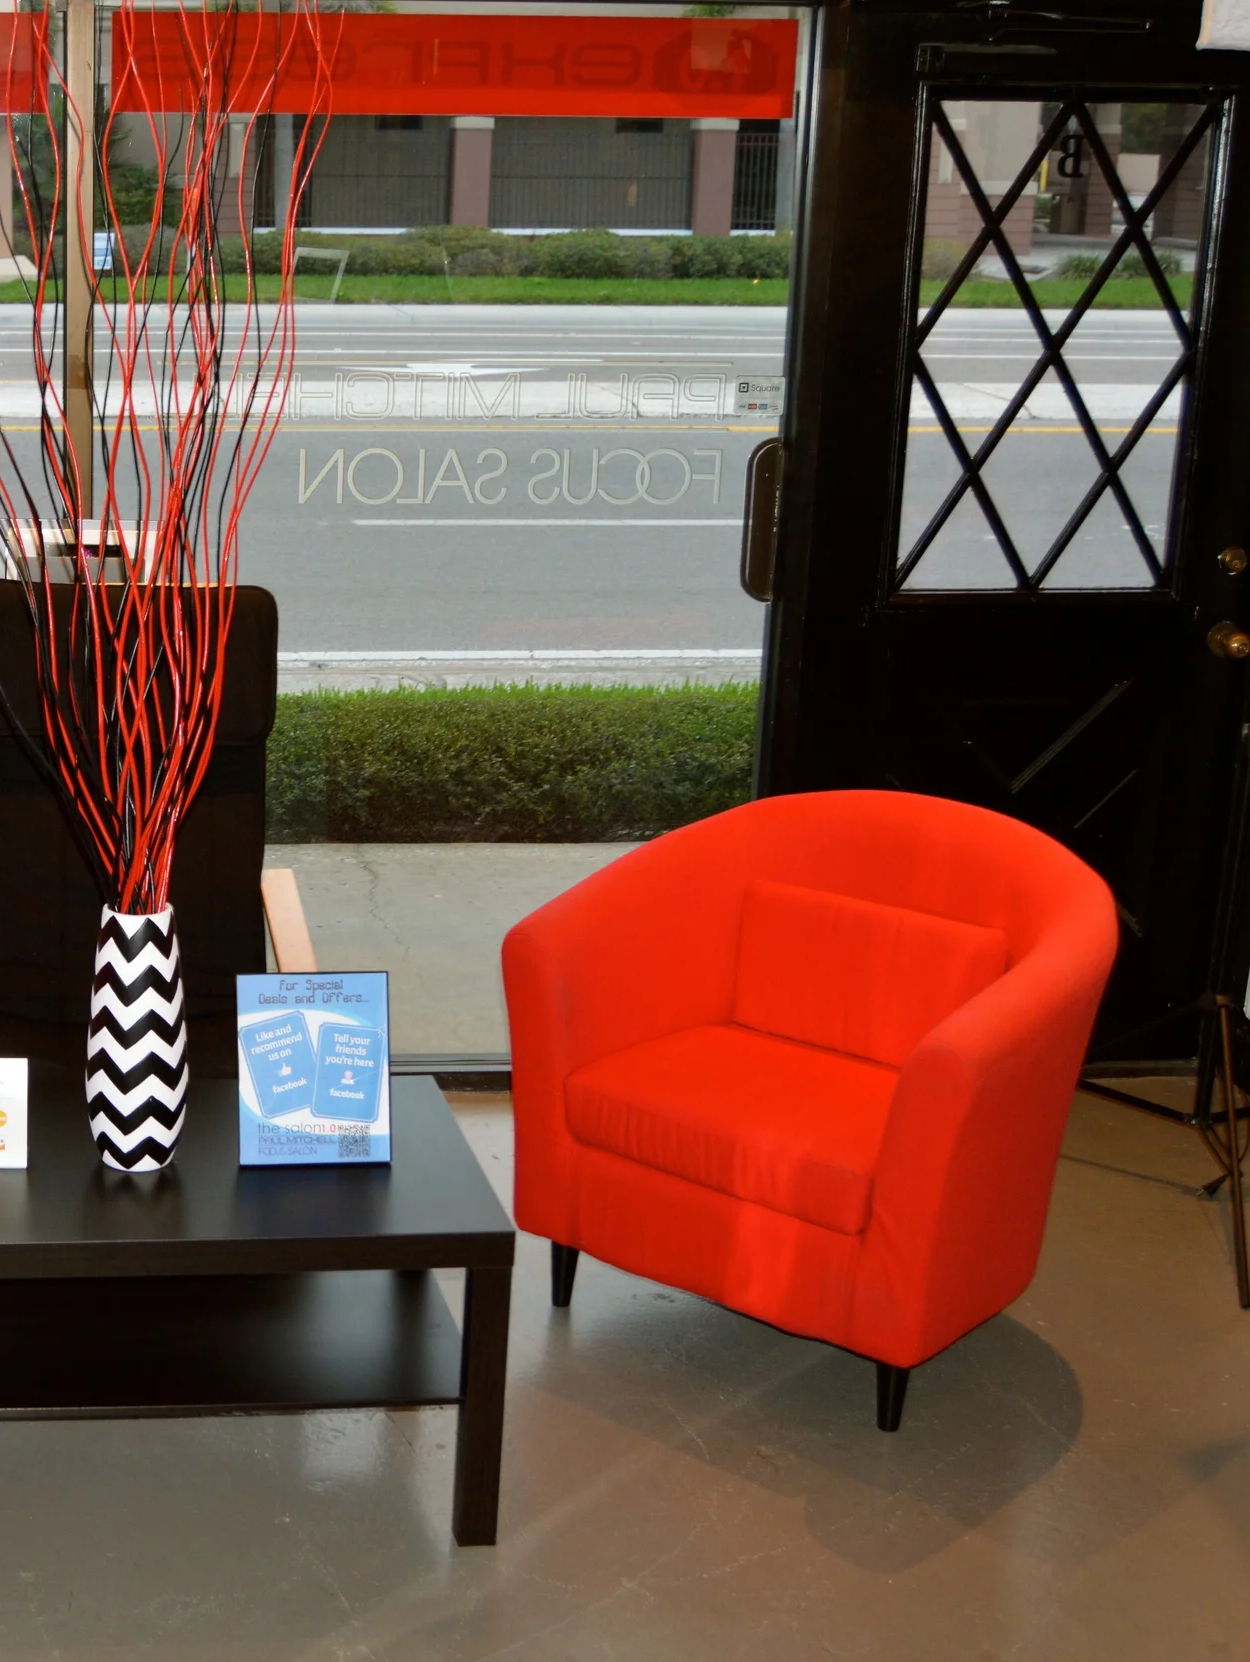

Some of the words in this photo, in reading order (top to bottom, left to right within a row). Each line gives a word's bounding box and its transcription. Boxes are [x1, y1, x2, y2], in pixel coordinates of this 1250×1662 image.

[751, 384, 780, 394] Square
[279, 980, 298, 991] For
[306, 979, 343, 995] Special
[259, 994, 287, 1004] Deals
[295, 993, 315, 1004] and
[255, 1030, 274, 1042] Like
[275, 1024, 292, 1037] and
[251, 1032, 303, 1055] recommend
[334, 1033, 349, 1043] Tell
[349, 1037, 371, 1046] your
[268, 1051, 280, 1061] us
[280, 1048, 292, 1058] on
[335, 1045, 367, 1056] friends
[325, 1055, 352, 1066] you're
[352, 1057, 374, 1068] here
[272, 1077, 307, 1094] facebook
[329, 1088, 366, 1100] facebook
[258, 1123, 282, 1134] the
[258, 1136, 285, 1146] PAUL
[287, 1136, 336, 1145] MITCHELL
[258, 1147, 286, 1156] FOCUS
[288, 1146, 318, 1156] SALON
